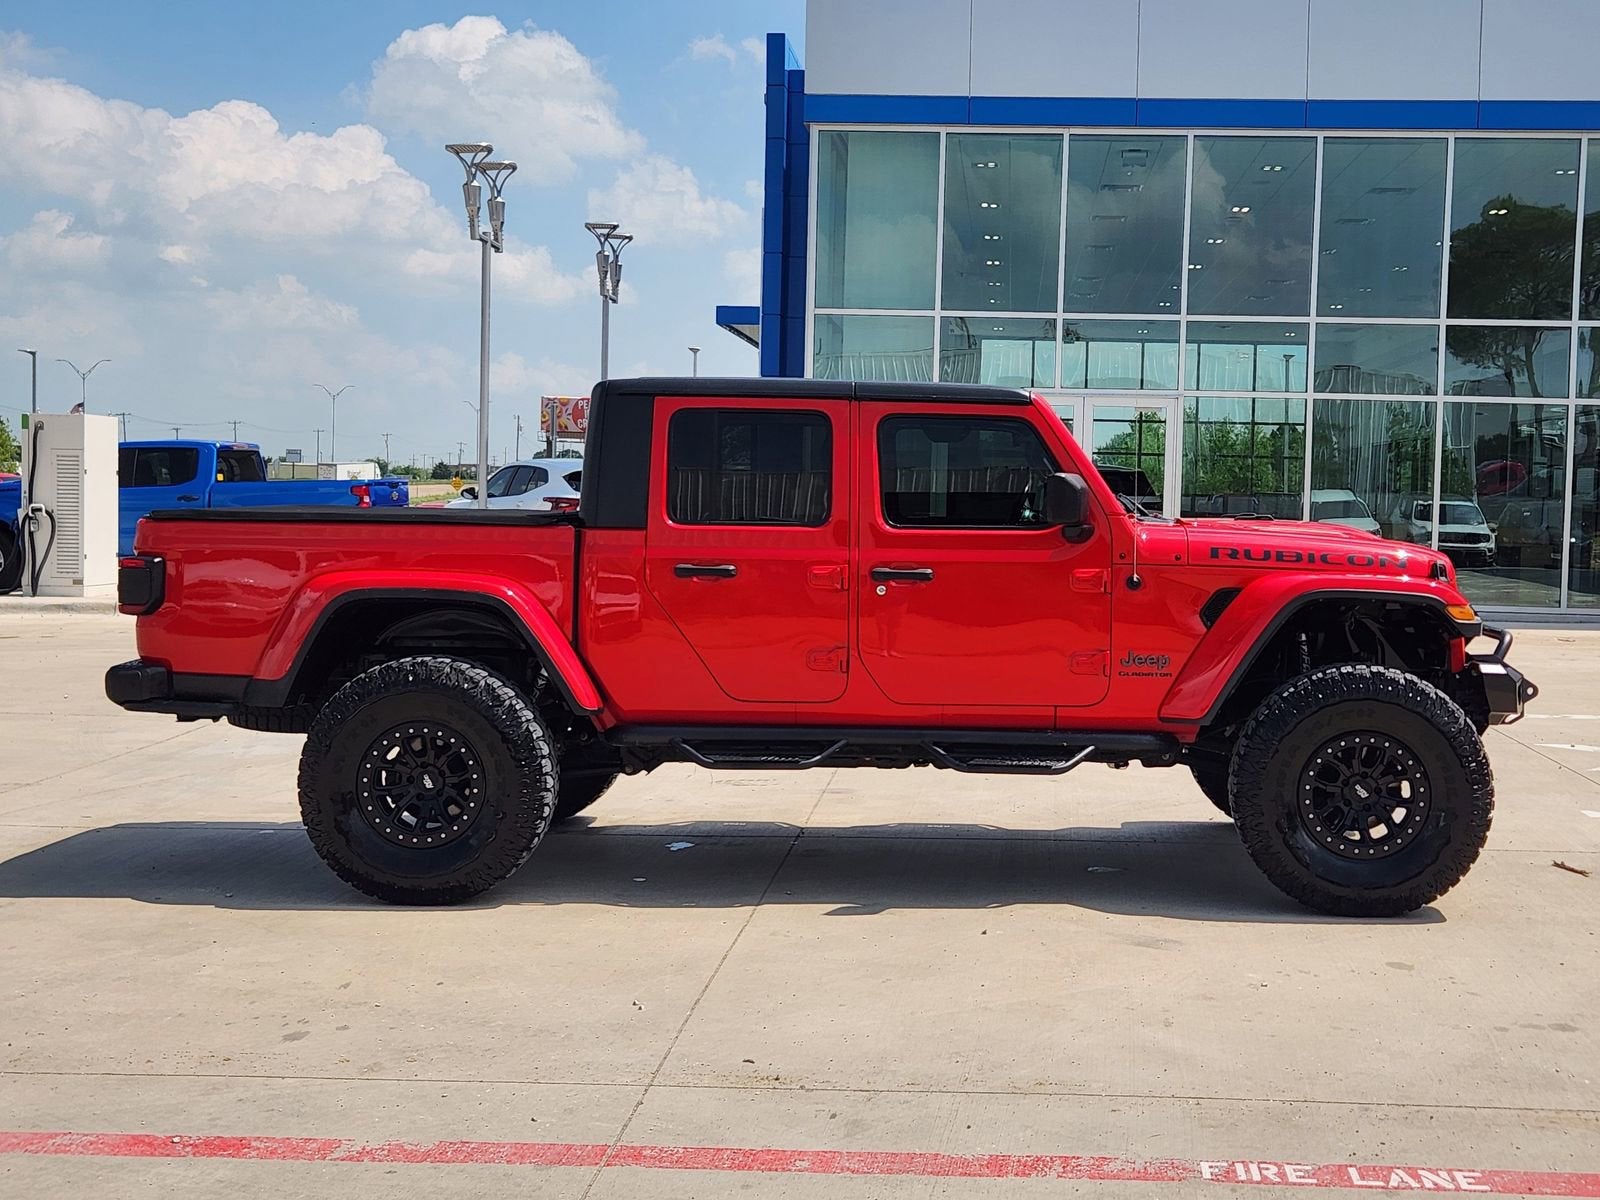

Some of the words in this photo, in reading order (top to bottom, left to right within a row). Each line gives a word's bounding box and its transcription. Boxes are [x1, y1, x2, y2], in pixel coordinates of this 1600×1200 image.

[1210, 546, 1407, 569] RUBICON
[1120, 650, 1170, 670] Jeep
[1200, 1161, 1318, 1184] FIRE
[1347, 1167, 1491, 1191] LANE
